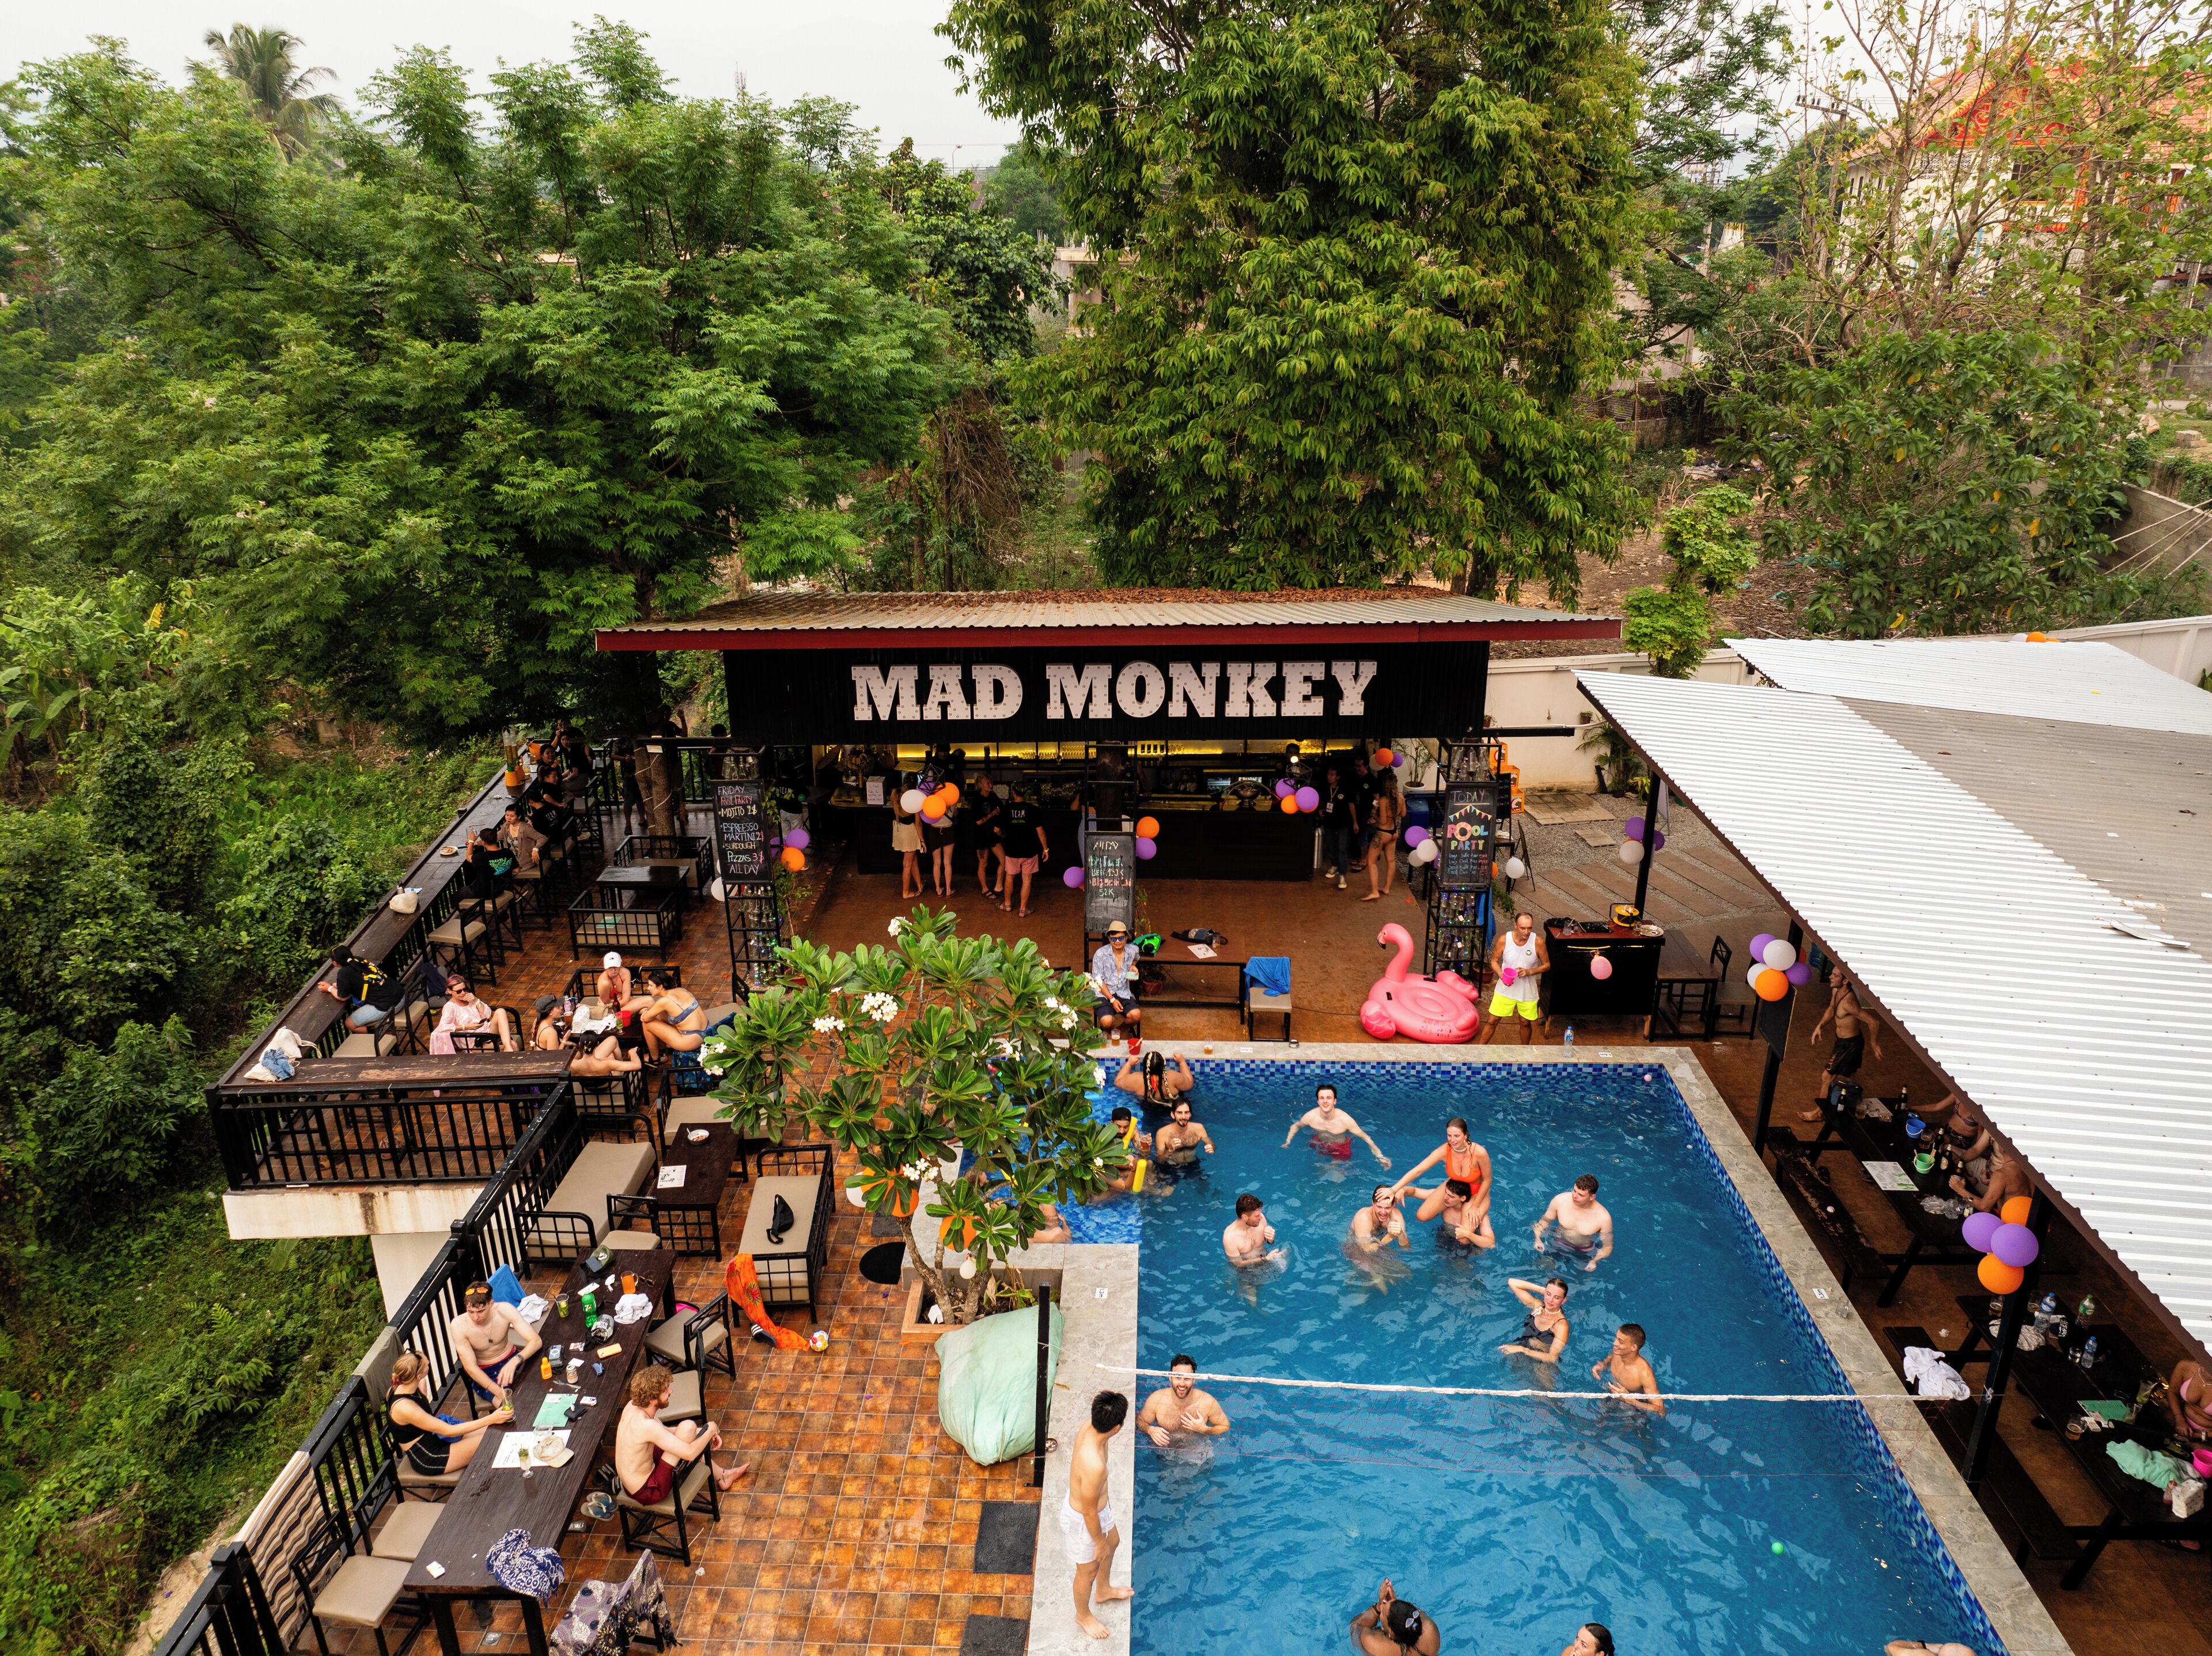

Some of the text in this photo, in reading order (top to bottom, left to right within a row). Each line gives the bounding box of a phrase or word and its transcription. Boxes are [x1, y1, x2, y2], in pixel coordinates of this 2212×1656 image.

[851, 661, 1378, 721] MAD MONKEY
[718, 785, 745, 795] FRIDAY
[1450, 789, 1485, 802] TODAY
[1011, 809, 1025, 818] TEAM
[725, 832, 756, 842] MARTINI
[1447, 822, 1488, 842] POOL
[1450, 840, 1485, 851] PARTY
[744, 864, 760, 876] DAY
[1817, 1289, 1825, 1298] 1.3m
